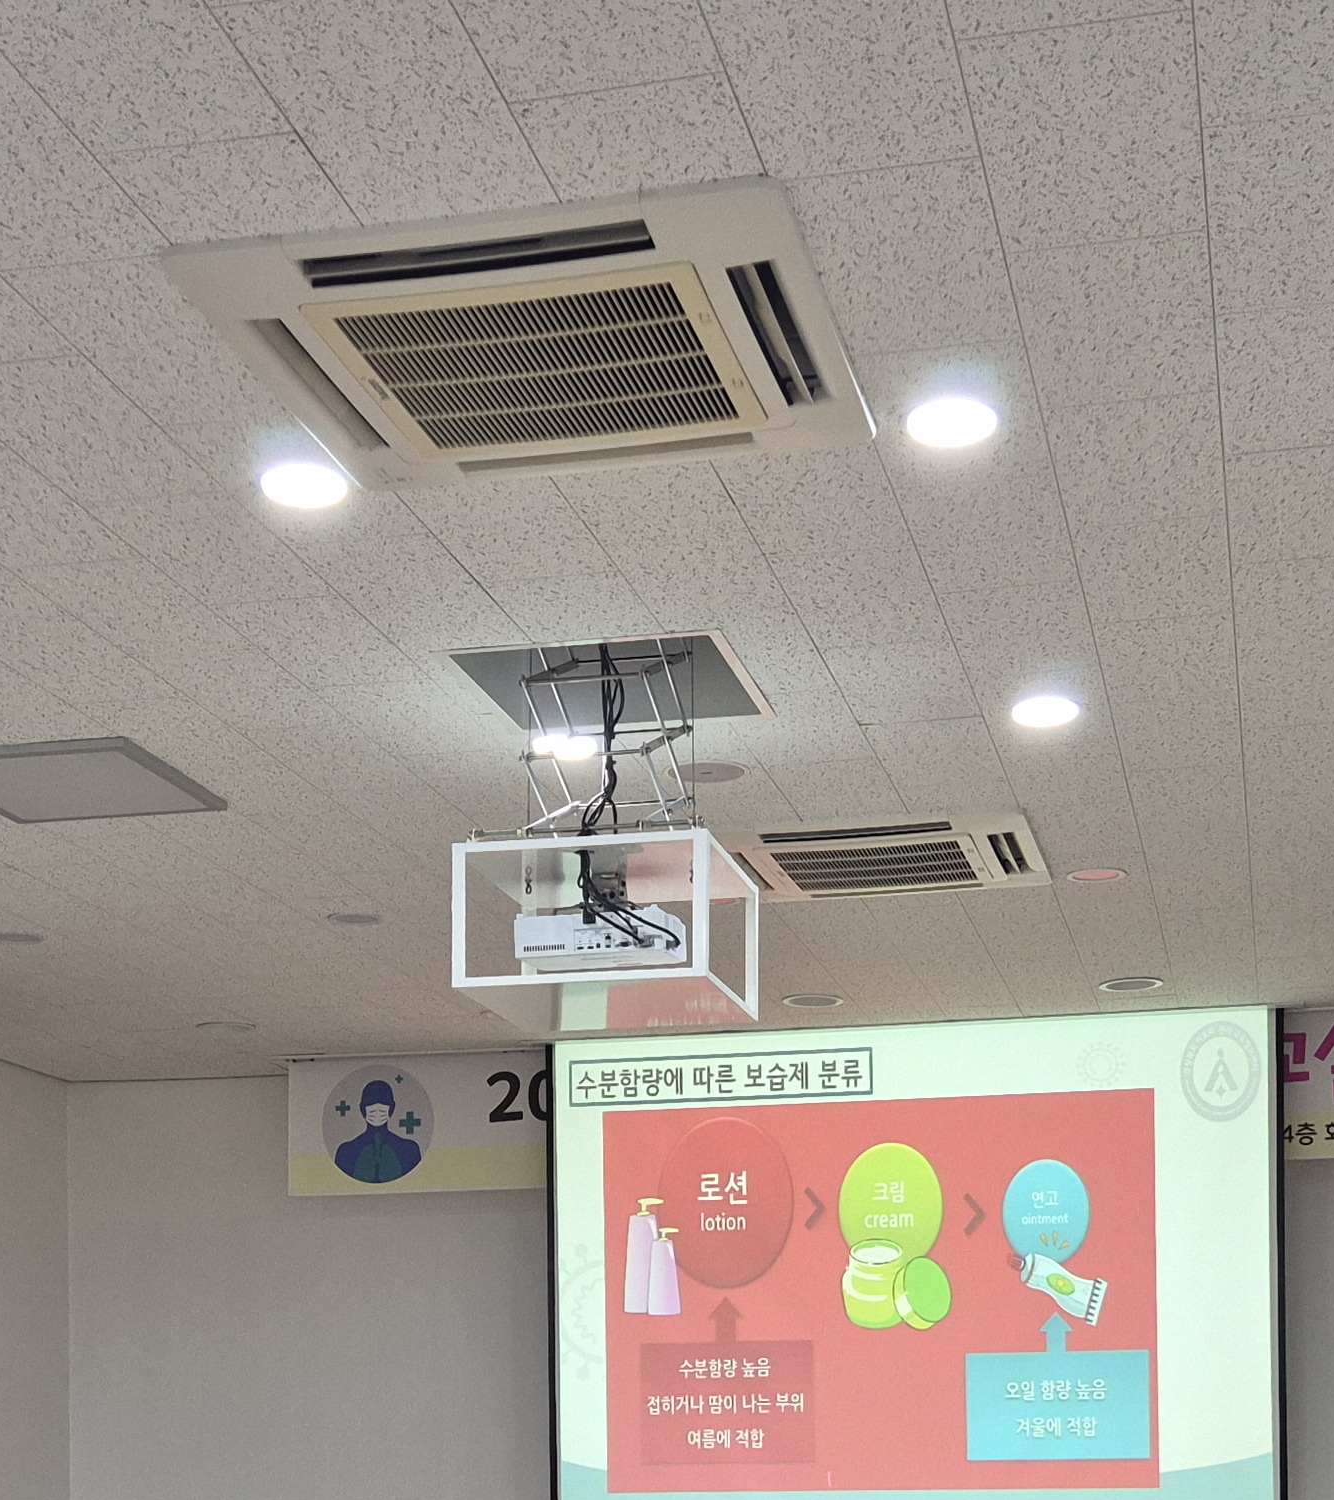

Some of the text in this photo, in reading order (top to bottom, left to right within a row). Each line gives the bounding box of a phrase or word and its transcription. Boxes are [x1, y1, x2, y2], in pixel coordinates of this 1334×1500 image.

[576, 1059, 863, 1099] 수분함량에 따른 보습제 분류
[1284, 1122, 1318, 1146] 4층
[697, 1170, 749, 1206] 로션
[871, 1180, 906, 1204] 크림
[1031, 1190, 1059, 1209] 연고
[700, 1212, 747, 1232] lotion
[864, 1211, 915, 1229] cream
[1021, 1213, 1069, 1225] ointment
[679, 1357, 772, 1379] 수분함량 높음
[1005, 1378, 1107, 1401] 오일 함량 높음
[647, 1392, 805, 1416] 접히거나 땀이 나는 부위
[1015, 1416, 1098, 1438] 겨울에 적합
[687, 1428, 765, 1449] 여름에 적합
